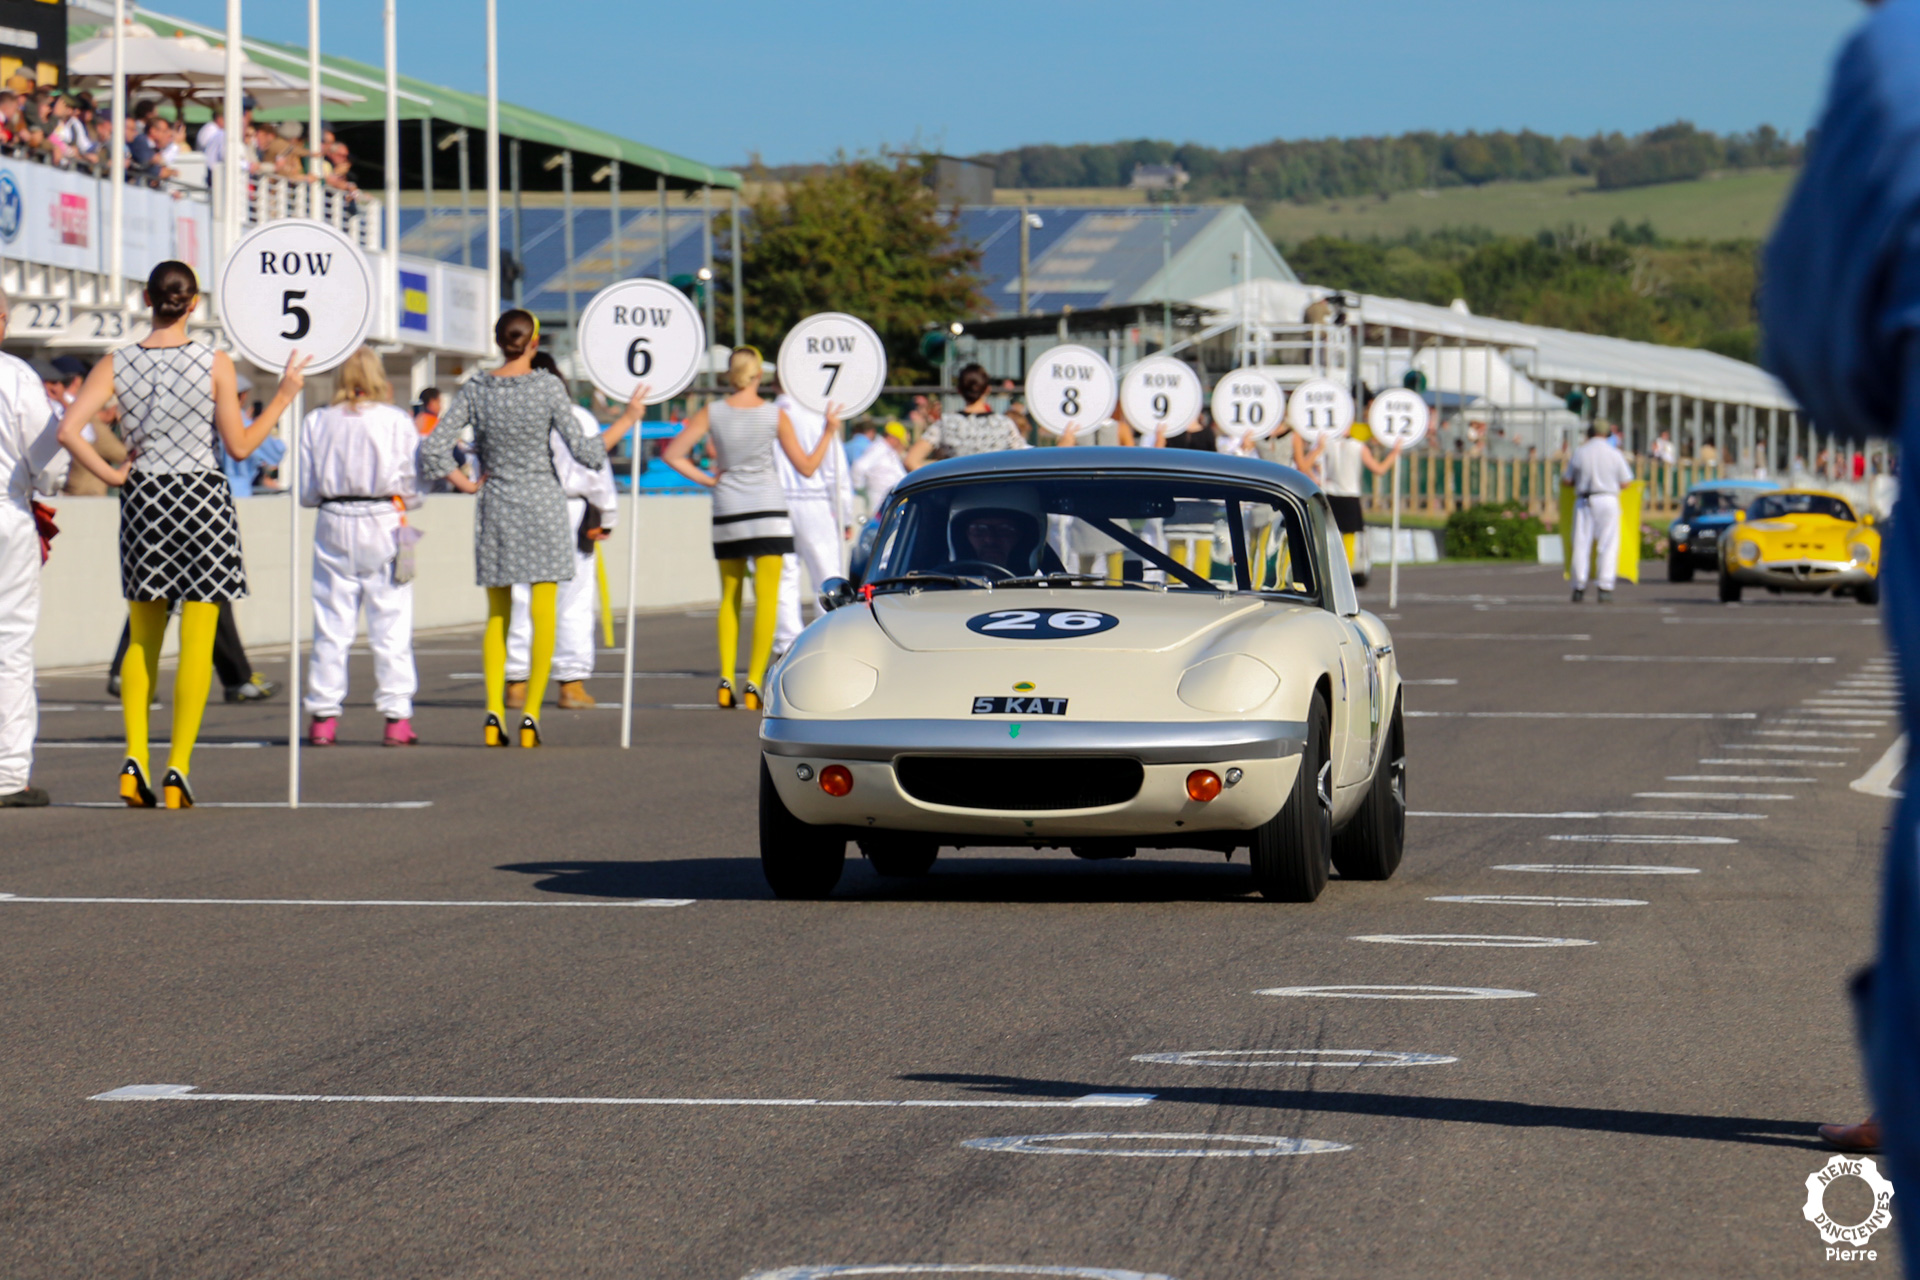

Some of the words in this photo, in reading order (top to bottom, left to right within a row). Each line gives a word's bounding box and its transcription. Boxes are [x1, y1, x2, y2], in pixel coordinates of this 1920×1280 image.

[260, 251, 332, 276] ROW
[29, 303, 62, 328] 22
[92, 312, 123, 338] 23
[280, 290, 311, 340] 5
[614, 305, 671, 327] ROW
[806, 336, 855, 354] ROW
[626, 337, 653, 377] 6
[820, 363, 841, 396] 7
[1051, 363, 1093, 381] ROW
[1143, 373, 1181, 388] ROW
[1232, 383, 1265, 397] ROW
[1305, 391, 1335, 404] ROW
[1061, 388, 1080, 416] 8
[1152, 394, 1169, 419] 9
[1385, 401, 1414, 413] ROW
[1232, 402, 1264, 425] 10
[1307, 408, 1336, 429] 11
[1385, 415, 1414, 436] 12
[981, 611, 1103, 630] 26
[974, 697, 996, 714] 5
[1004, 698, 1067, 714] KAT
